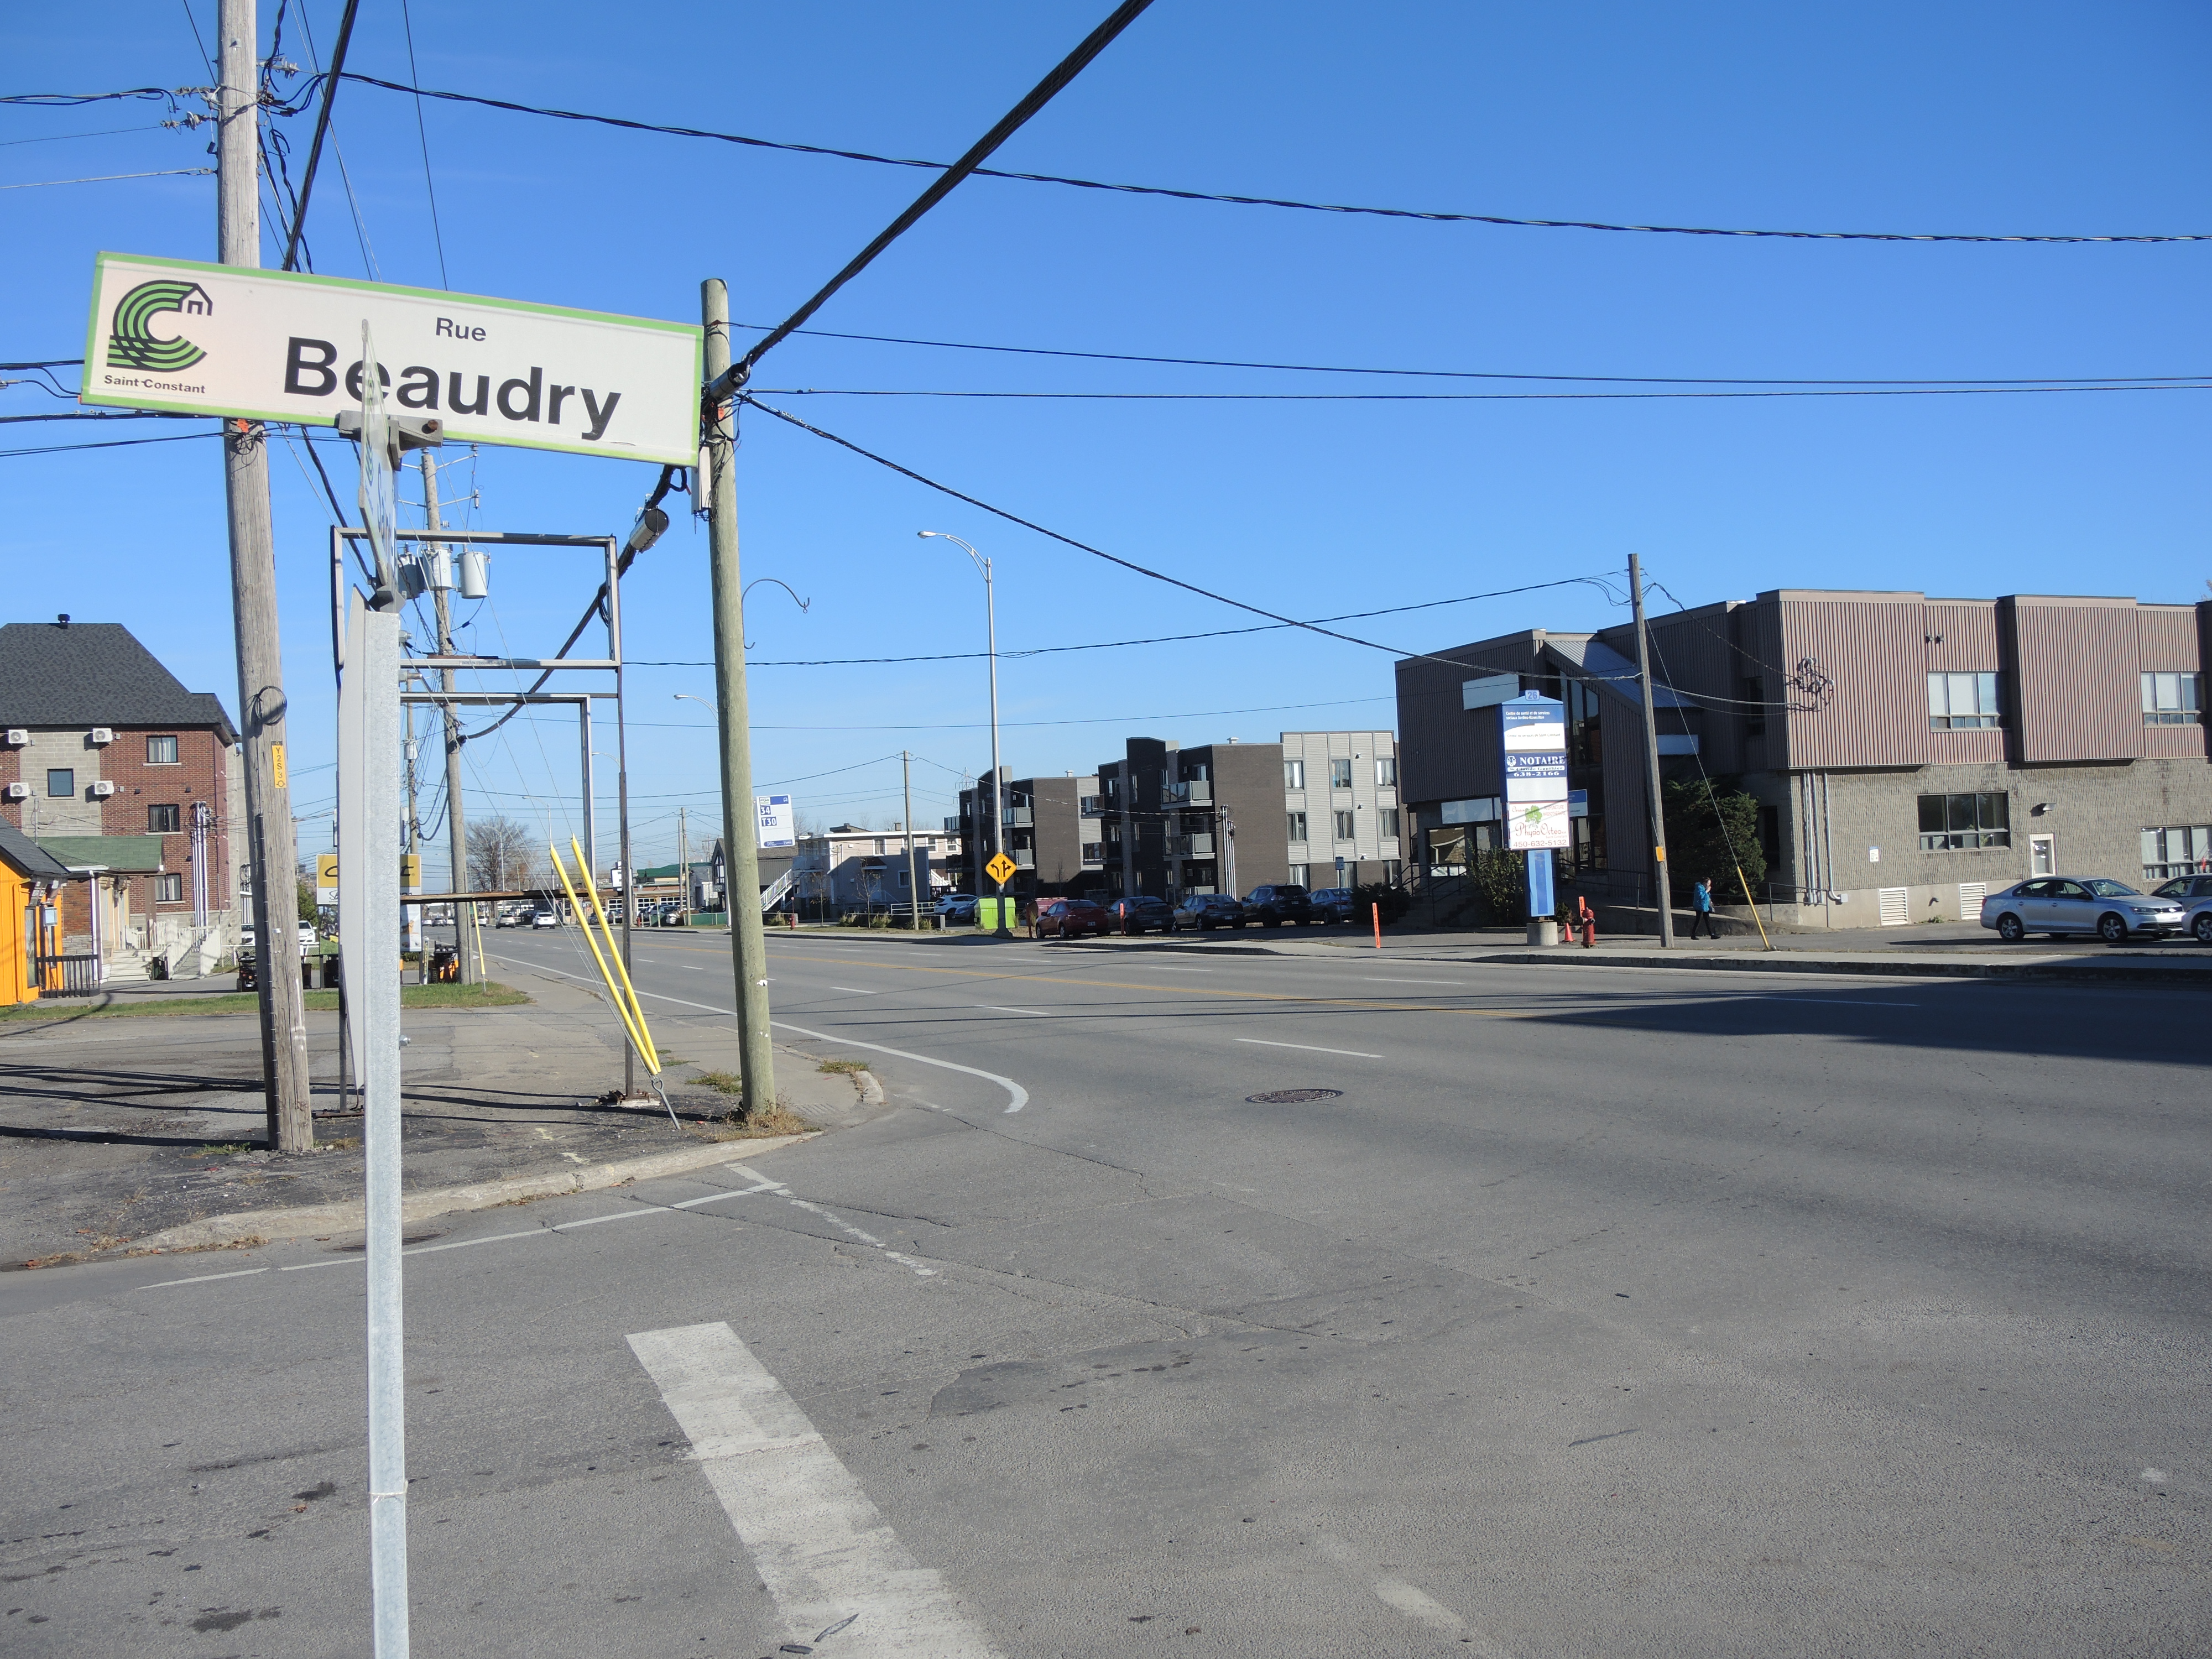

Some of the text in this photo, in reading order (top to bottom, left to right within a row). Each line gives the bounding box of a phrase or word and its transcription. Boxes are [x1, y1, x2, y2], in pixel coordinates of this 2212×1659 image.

[435, 317, 487, 342] Rue
[104, 374, 206, 394] Saint-Constant
[284, 337, 622, 440] Beaudry
[1527, 691, 1537, 700] 26
[1520, 756, 1565, 765] NOTAIRE
[761, 817, 776, 826] T30
